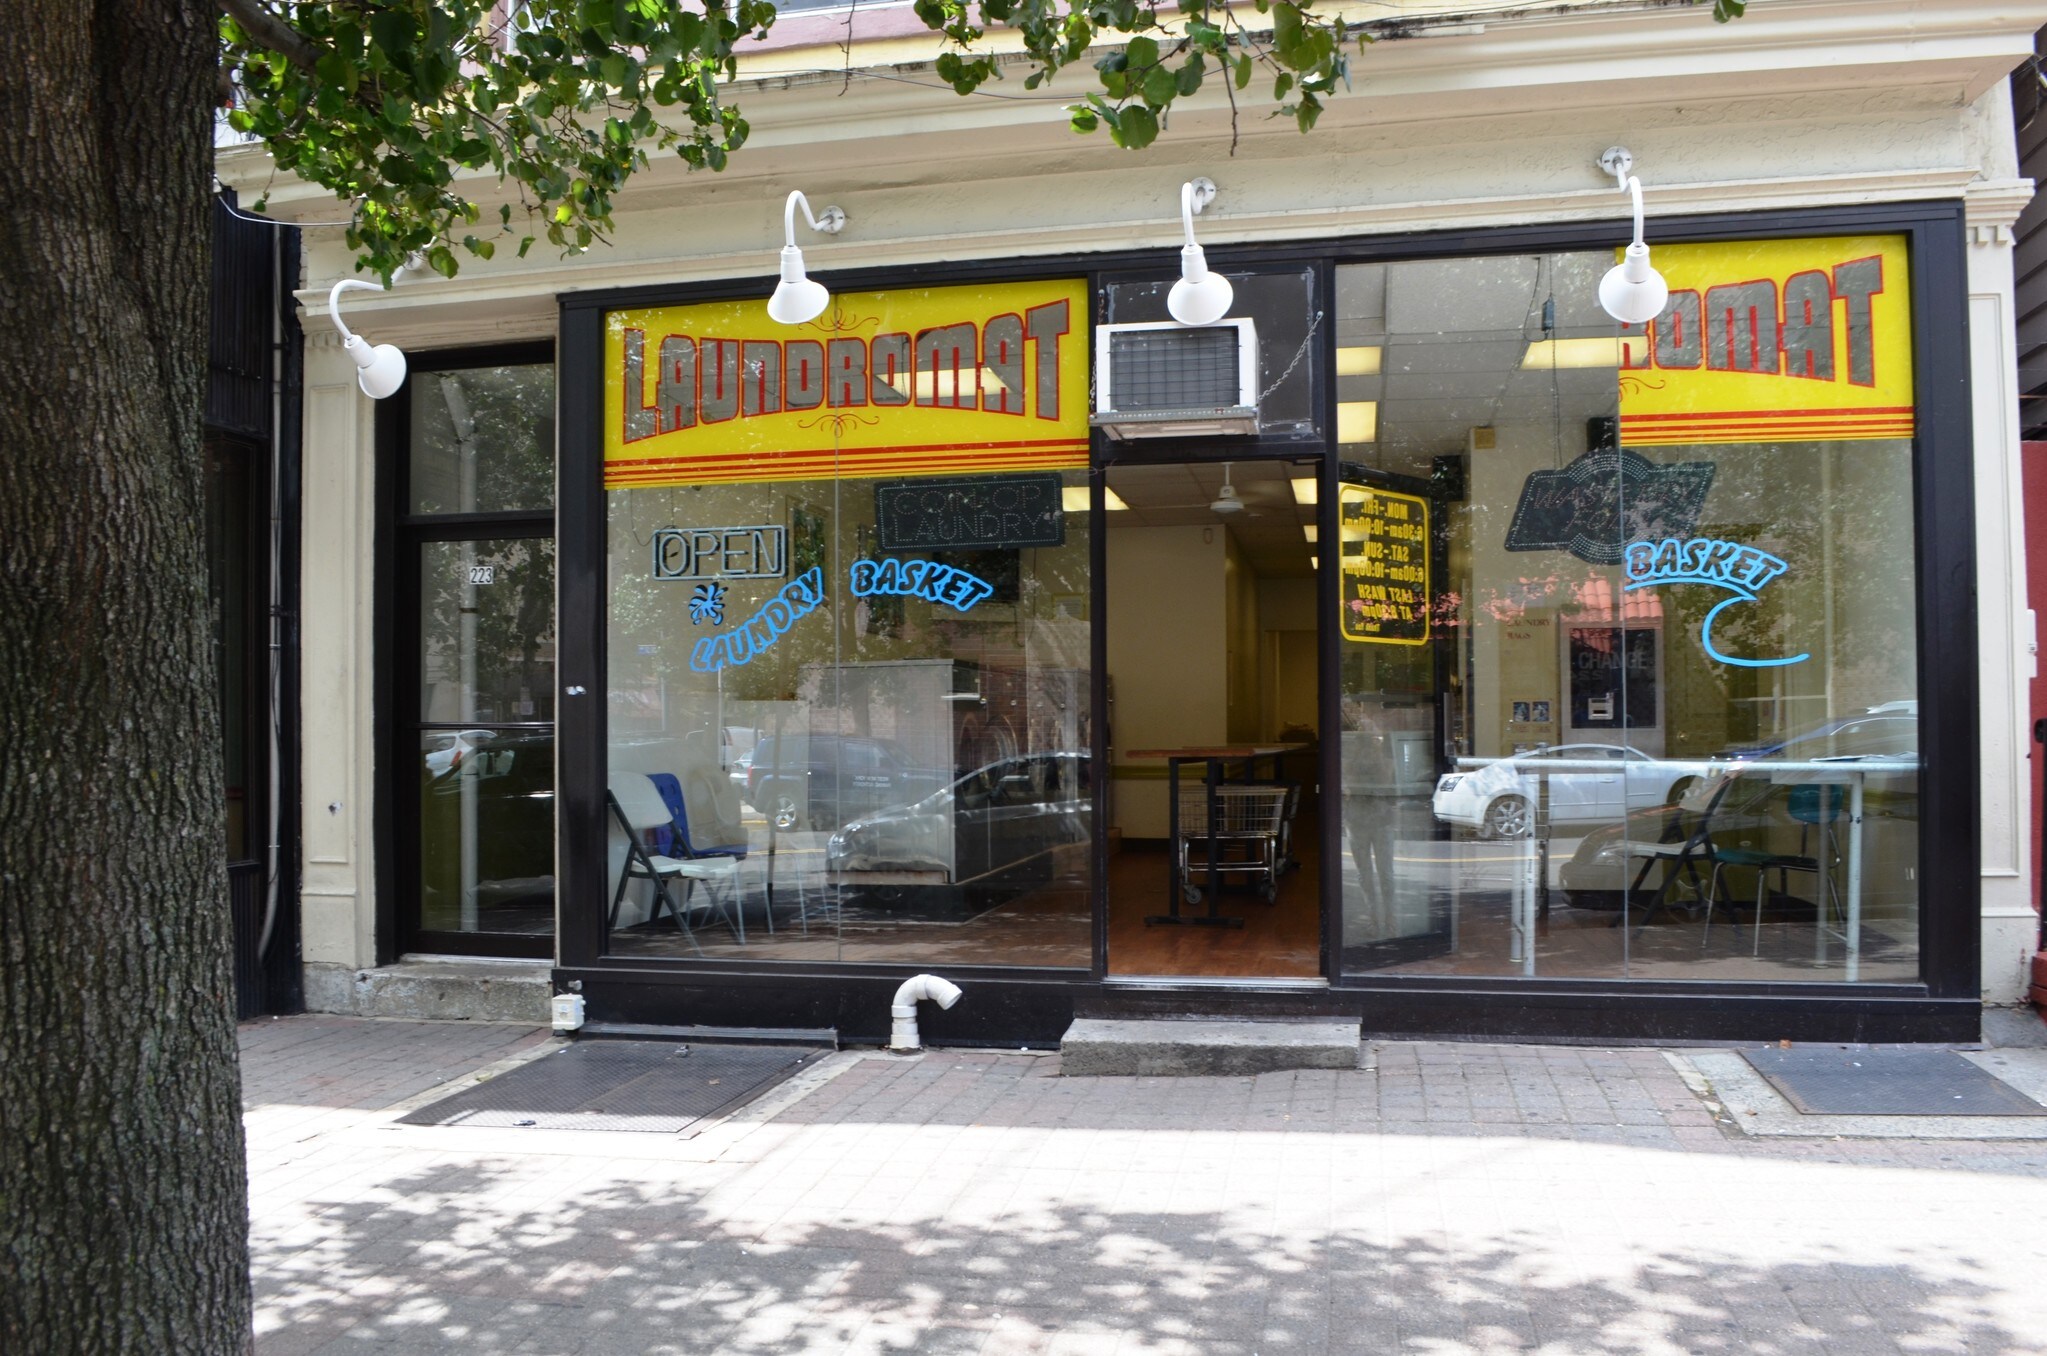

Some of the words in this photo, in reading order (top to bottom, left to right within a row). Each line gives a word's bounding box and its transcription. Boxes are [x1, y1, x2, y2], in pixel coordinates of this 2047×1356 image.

[622, 298, 1070, 445] LAUNDROMAT
[893, 485, 1041, 515] COIN-OP
[894, 511, 1044, 542] LAUNDRY
[657, 530, 781, 577] OPEN
[1625, 538, 1788, 590] BASKET
[471, 568, 492, 583] 223
[690, 566, 824, 672] LAUNDRY
[849, 558, 993, 612] BASKET
[1579, 651, 1647, 669] CHANGE
